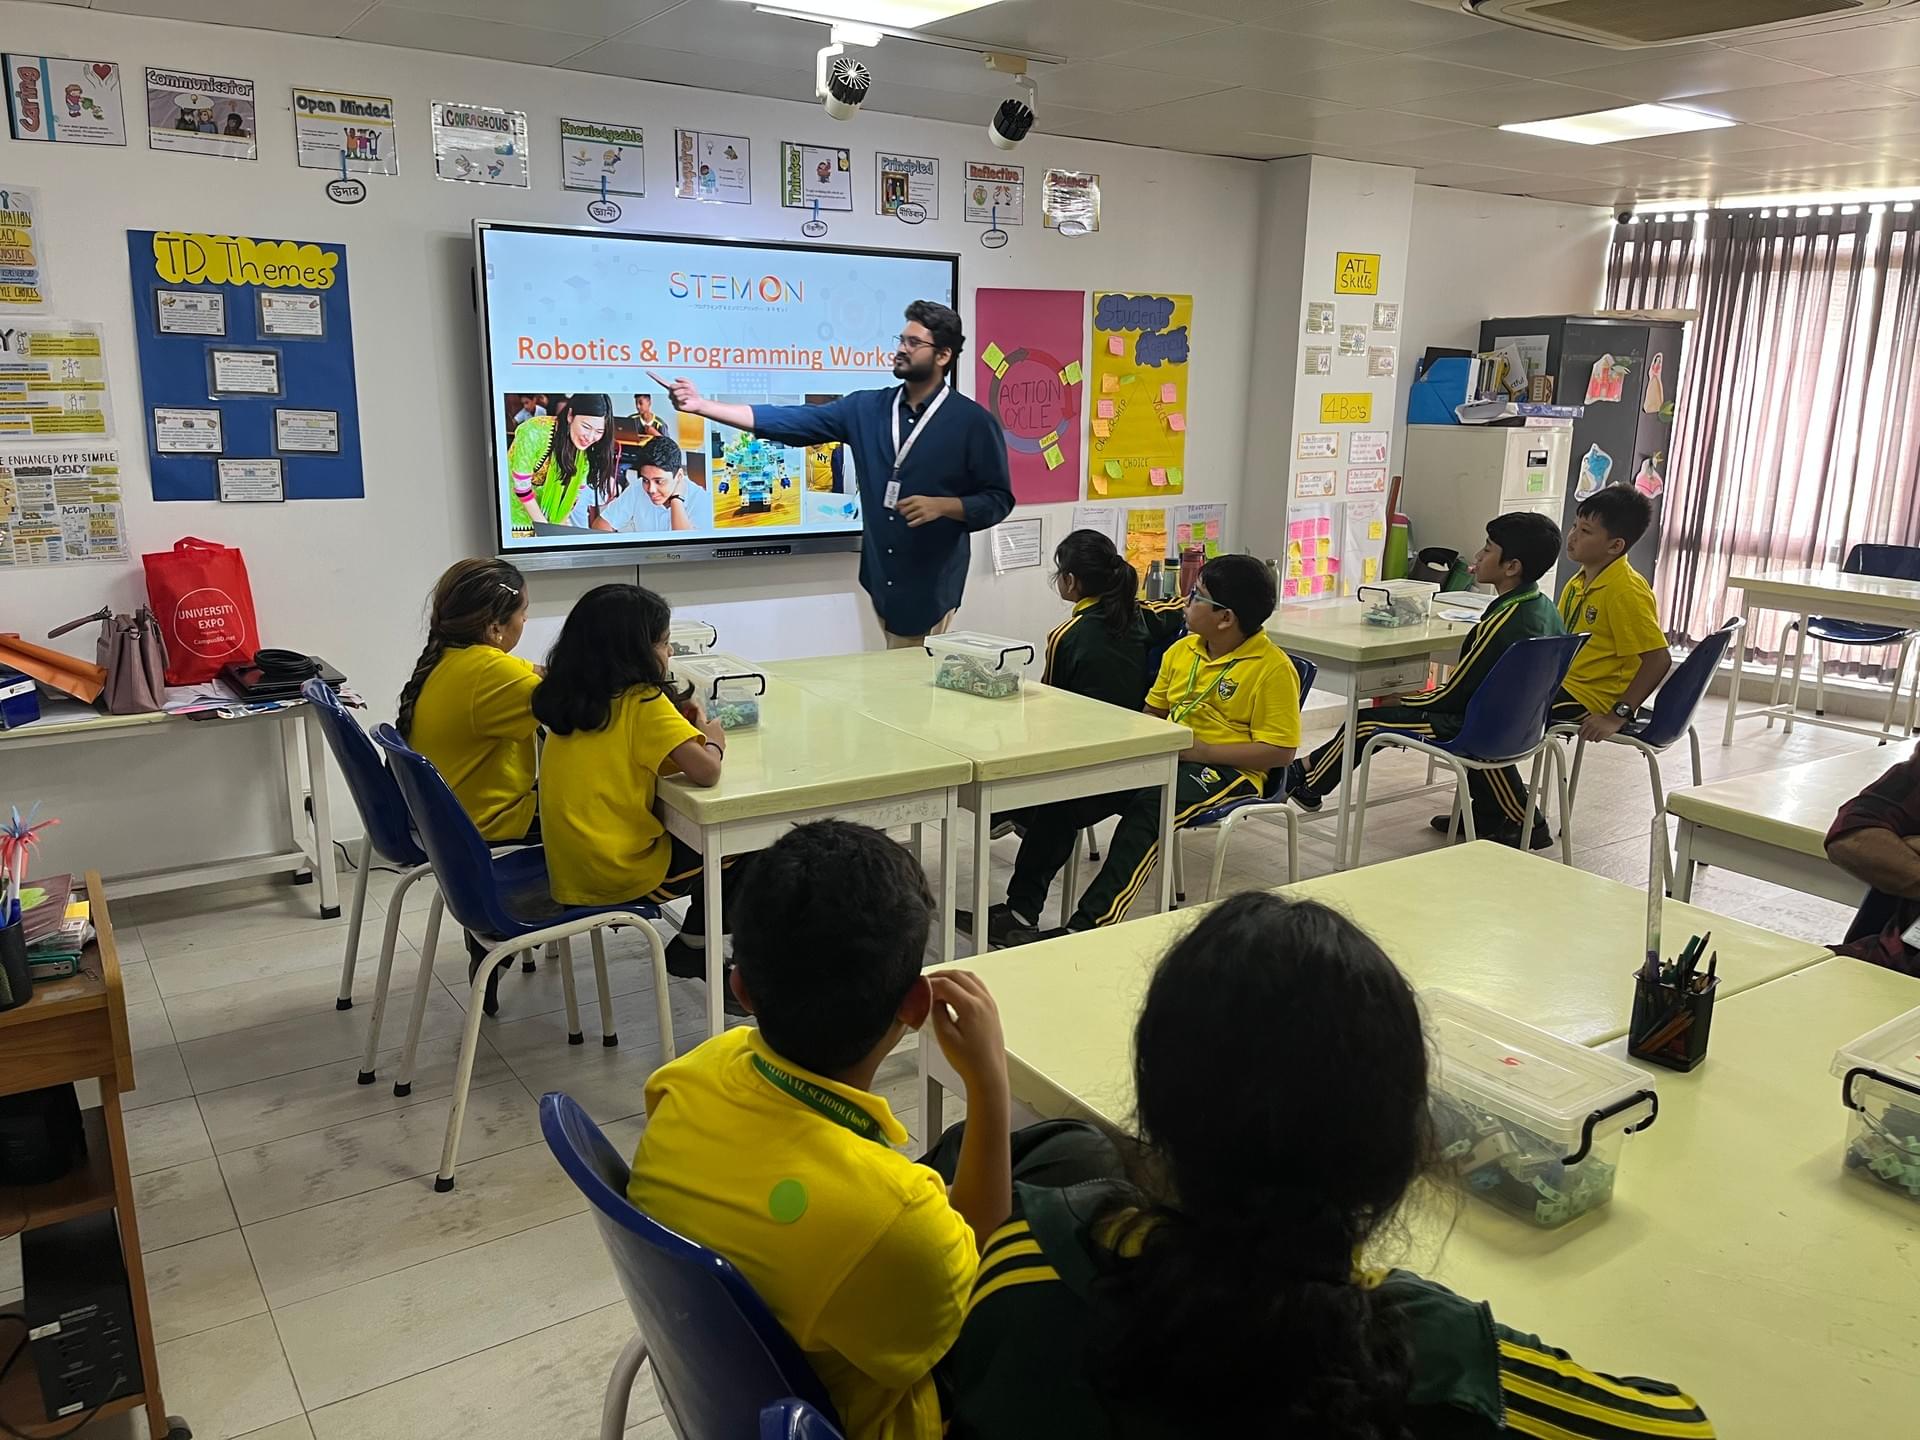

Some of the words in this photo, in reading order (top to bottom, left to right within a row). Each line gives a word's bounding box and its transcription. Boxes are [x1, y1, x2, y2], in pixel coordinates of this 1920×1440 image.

[146, 70, 253, 97] Communicator
[15, 66, 41, 133] Caring
[296, 95, 337, 114] Open
[340, 99, 391, 119] Minded
[561, 121, 643, 143] Knowledgeable
[681, 132, 697, 195] Inquirer
[787, 146, 801, 205] Thinker
[881, 157, 934, 176] Principled
[970, 165, 1020, 182] Reflective
[0, 229, 16, 241] ACY
[157, 237, 208, 276] TD
[216, 241, 330, 287] Themes
[1344, 259, 1372, 273] ATL
[669, 272, 805, 303] STEMON
[1341, 273, 1372, 289] Skills
[1103, 300, 1166, 327] Student
[518, 336, 632, 362] Robotics
[639, 339, 660, 362] &
[668, 340, 824, 370] Programming
[1000, 379, 1061, 405] ACTION
[1005, 404, 1052, 429] CYCLE
[1323, 397, 1339, 419] 4
[1340, 397, 1367, 420] Be's
[1095, 399, 1128, 452] OWERSHIP
[8, 454, 59, 466] ENHANCED
[62, 454, 79, 464] PYP
[82, 453, 116, 463] SIMPLE
[54, 465, 86, 475] AGENCY
[1123, 458, 1148, 469] CHOICE
[178, 604, 234, 620] UNIVERSITY
[198, 617, 225, 630] EXPO
[806, 1086, 847, 1118] SCHOOL
